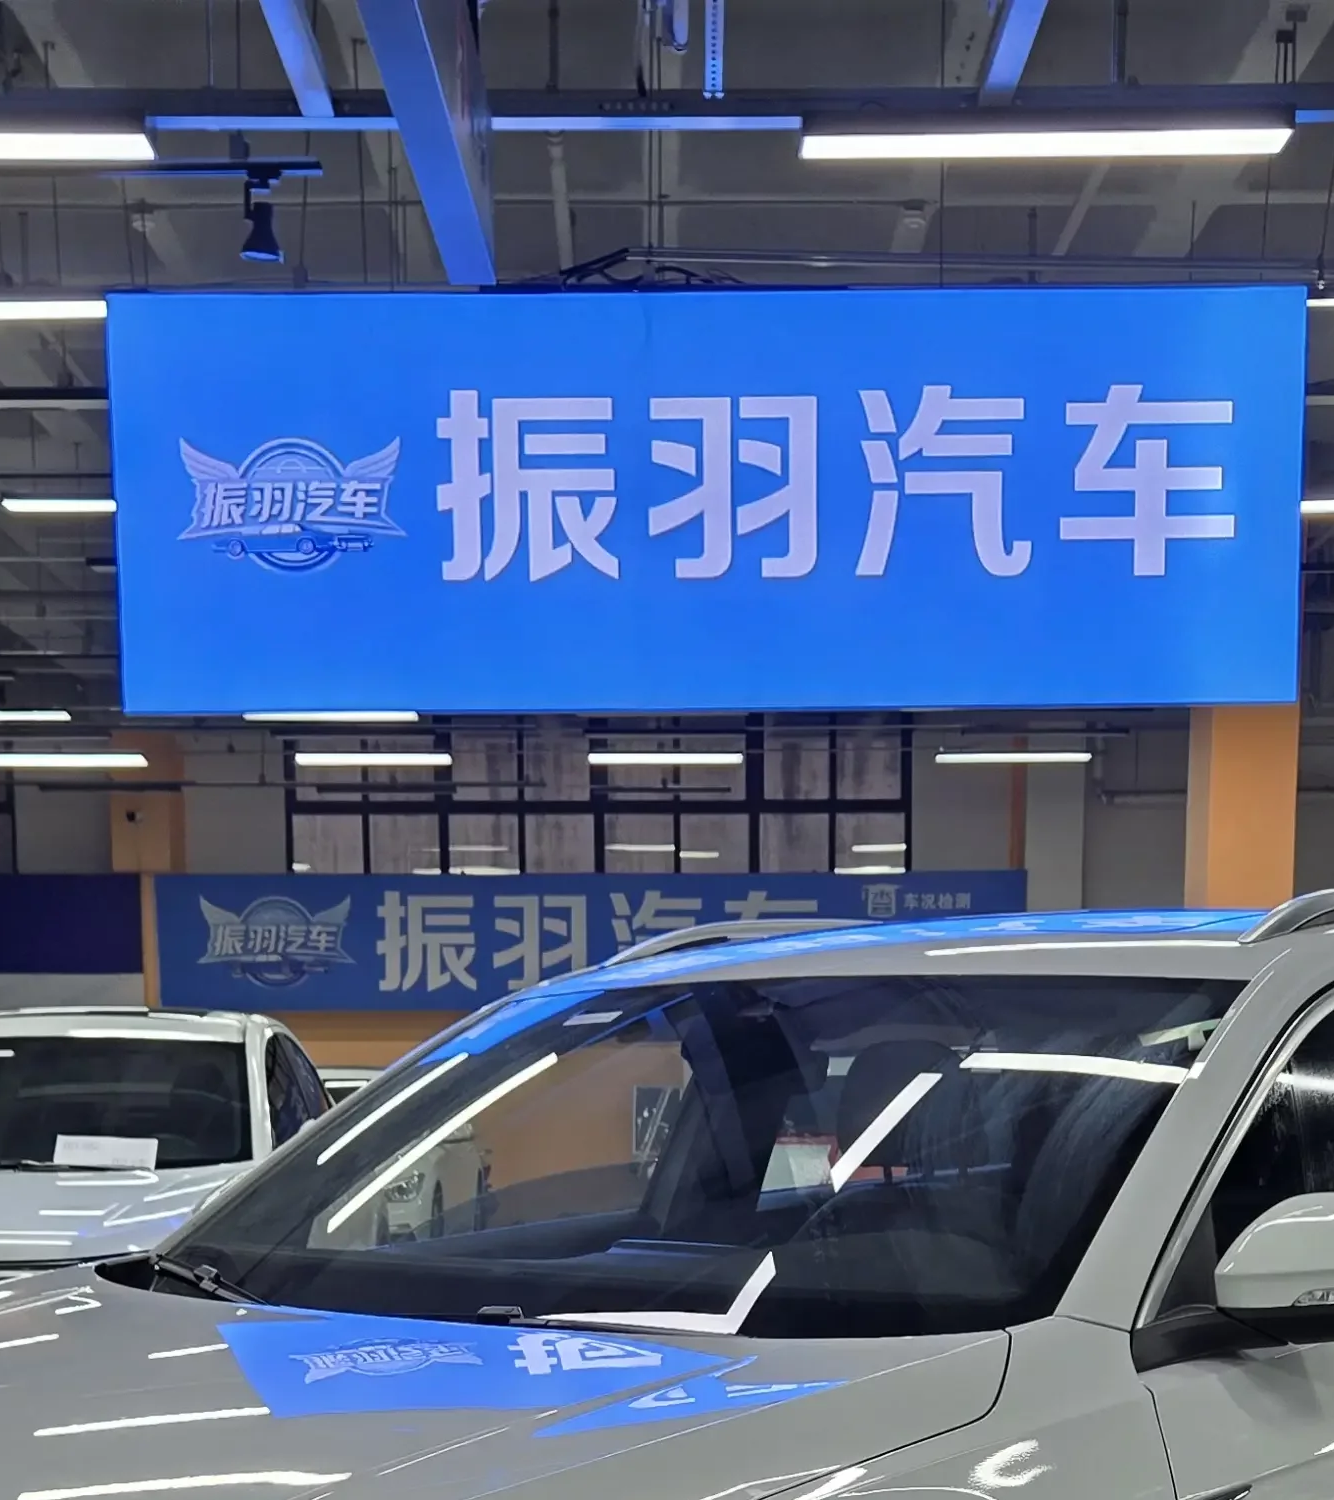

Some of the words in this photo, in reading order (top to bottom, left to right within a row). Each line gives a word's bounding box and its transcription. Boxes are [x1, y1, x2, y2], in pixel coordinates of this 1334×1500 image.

[200, 479, 382, 529] 振羽汽车
[434, 383, 1237, 583] 振羽汽车
[213, 924, 339, 956] 振羽汽车
